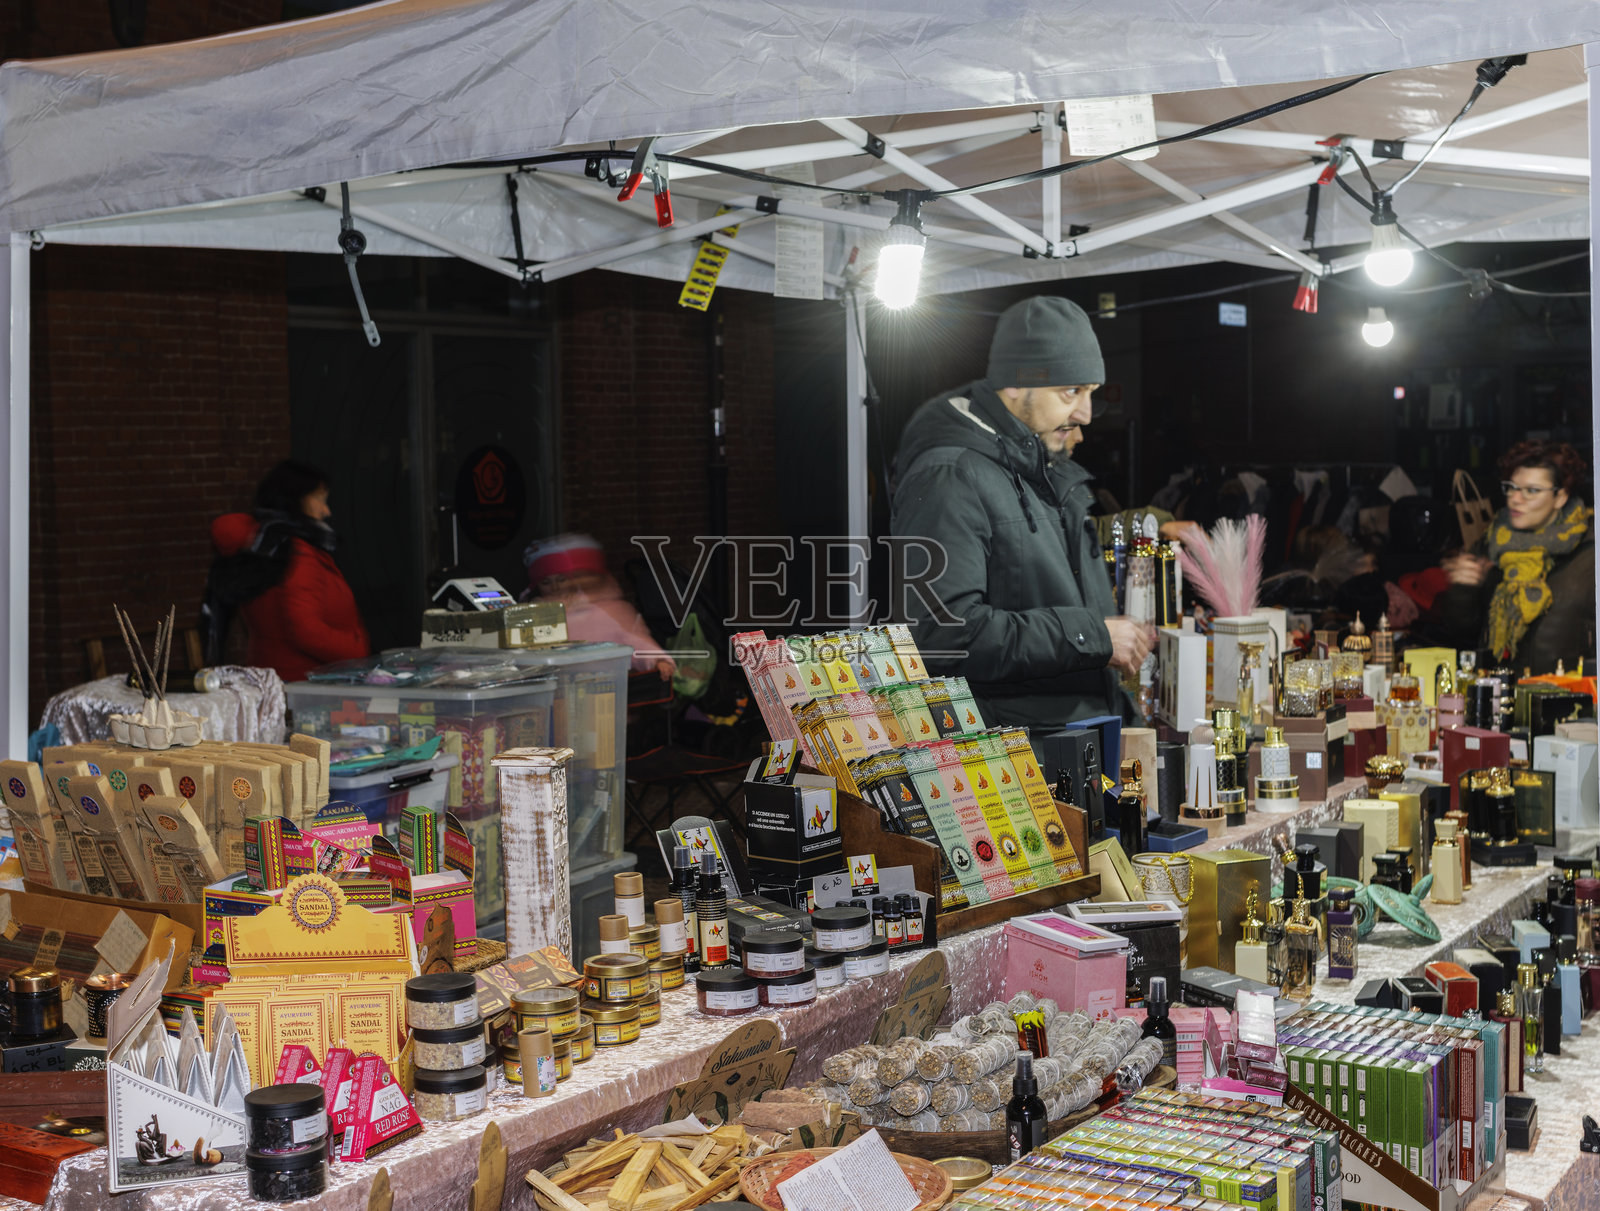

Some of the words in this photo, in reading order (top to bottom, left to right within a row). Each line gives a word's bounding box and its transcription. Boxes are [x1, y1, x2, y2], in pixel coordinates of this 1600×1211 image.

[337, 828, 357, 836] AROMA
[350, 1019, 381, 1028] SANDAL
[281, 1029, 313, 1037] SANDAL
[710, 1035, 776, 1074] Sahumitos
[378, 1091, 400, 1104] GOLDEN
[380, 1096, 402, 1116] NAG
[375, 1118, 391, 1135] RED
[391, 1108, 411, 1127] ROSE
[1339, 1129, 1383, 1168] SECRETS
